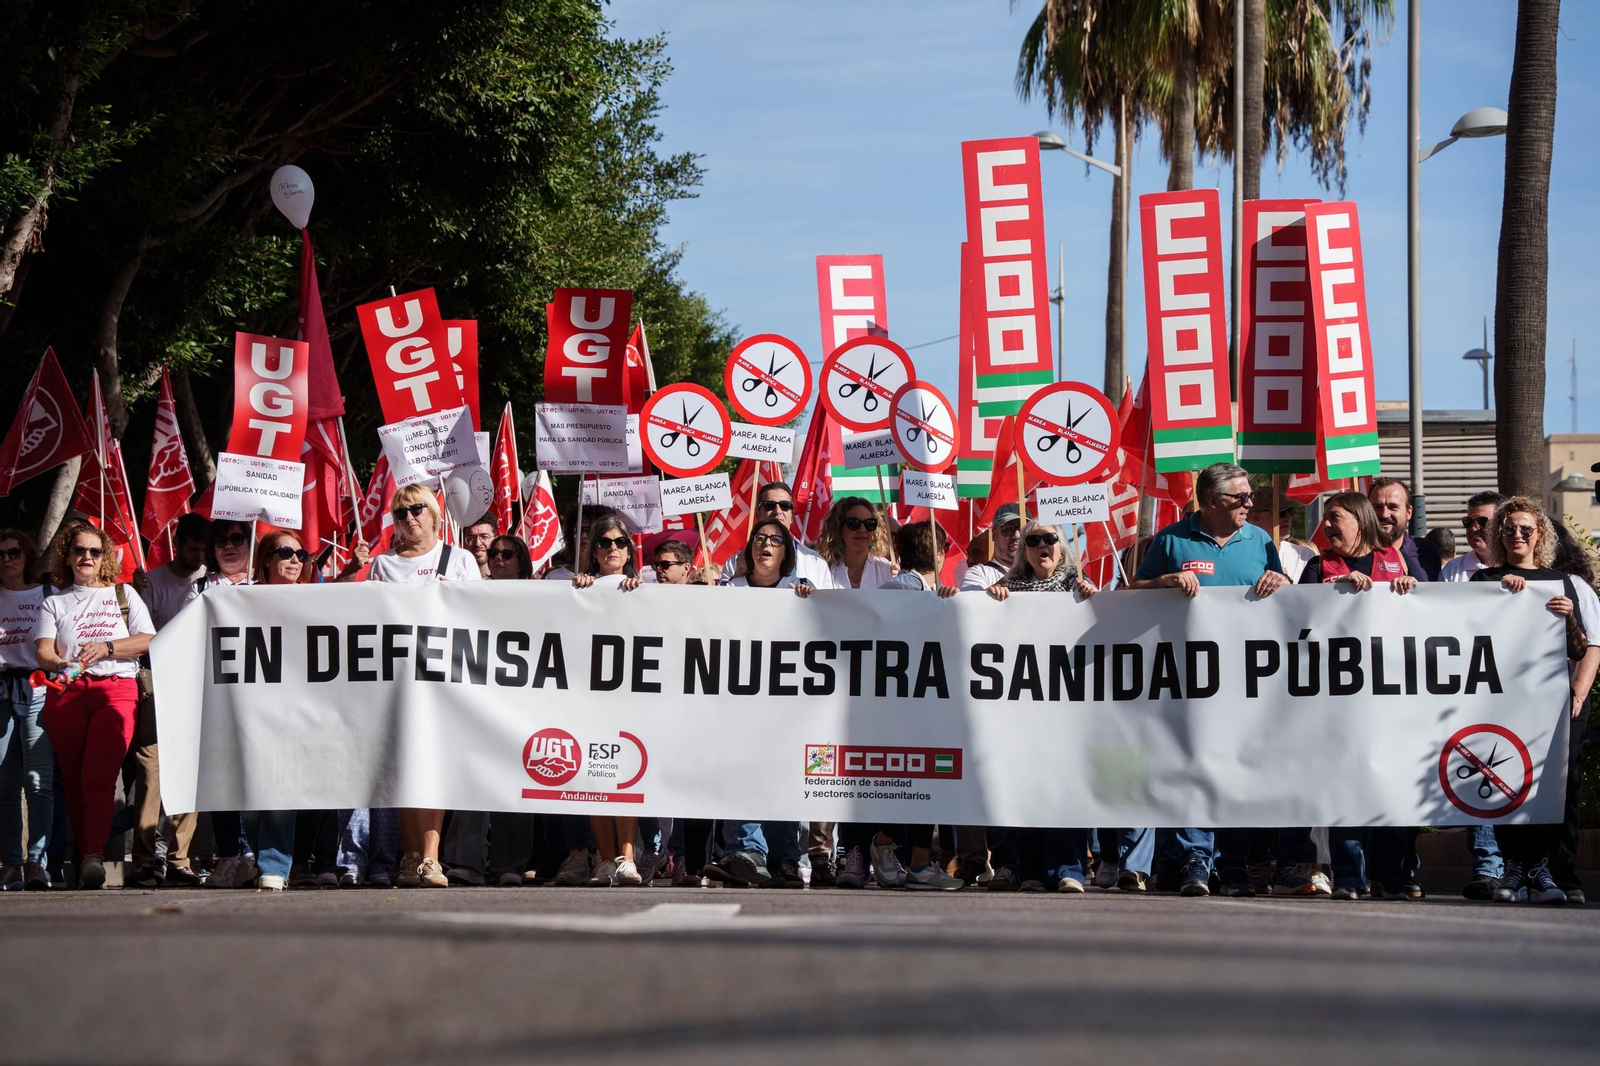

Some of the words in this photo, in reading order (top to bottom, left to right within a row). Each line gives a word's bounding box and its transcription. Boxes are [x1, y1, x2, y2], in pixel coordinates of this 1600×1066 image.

[976, 149, 1038, 366] CCOO
[1155, 202, 1217, 421] CCOO
[1253, 211, 1306, 424] CCOO
[1316, 213, 1368, 428] CCOO
[374, 298, 440, 412] UGT
[562, 296, 616, 402] UGT
[738, 358, 752, 370] MAREA
[760, 374, 778, 386] BLANCA
[834, 364, 850, 375] MAREA
[859, 377, 877, 390] BLANCA
[248, 342, 294, 456] UGT
[650, 416, 666, 426] MAREA
[676, 424, 696, 436] BLANCA
[730, 429, 756, 440] MAREA
[760, 432, 791, 443] BLANCA
[1028, 415, 1047, 427] MAREA
[1057, 428, 1078, 440] BLANCA
[1084, 438, 1109, 452] ALMERÍA
[404, 436, 456, 453] CONDICIONES
[741, 443, 778, 454] ALMERÍA
[846, 440, 872, 451] MAREA
[876, 438, 895, 448] BLAN
[408, 449, 458, 465] LABORALES!!!
[860, 450, 895, 461] ALMERÍA
[246, 470, 277, 481] SANIDAD
[663, 486, 692, 495] MAREA
[695, 481, 728, 491] BLANCA
[905, 478, 928, 488] MAREA
[929, 481, 955, 490] BLANCA
[678, 495, 716, 506] ALMERÍA
[917, 490, 946, 501] ALMERÍA
[1040, 496, 1069, 506] MAREA
[1072, 494, 1106, 503] BLANCA
[1054, 506, 1092, 517] ALMERÍA
[1182, 562, 1214, 570] CCOO
[0, 626, 32, 635] anidad
[76, 621, 117, 631] Sanidad
[0, 636, 26, 645] ública
[77, 629, 113, 639] Pública
[211, 626, 282, 684] EN
[306, 624, 569, 690] DEFENSA
[590, 634, 664, 694] DE
[683, 638, 950, 699] NUESTRA
[969, 640, 1220, 702] SANIDAD
[1246, 628, 1504, 698] PÚBLICA
[530, 736, 574, 760] UGT
[588, 761, 618, 770] Servicios
[844, 752, 925, 772] CCOO
[588, 770, 616, 778] Públicos
[804, 777, 856, 786] federación
[859, 778, 871, 786] de
[873, 779, 912, 788] sanidad
[560, 791, 608, 801] Andalucía
[812, 789, 854, 798] sectores
[857, 790, 931, 800] sociosanitarios
